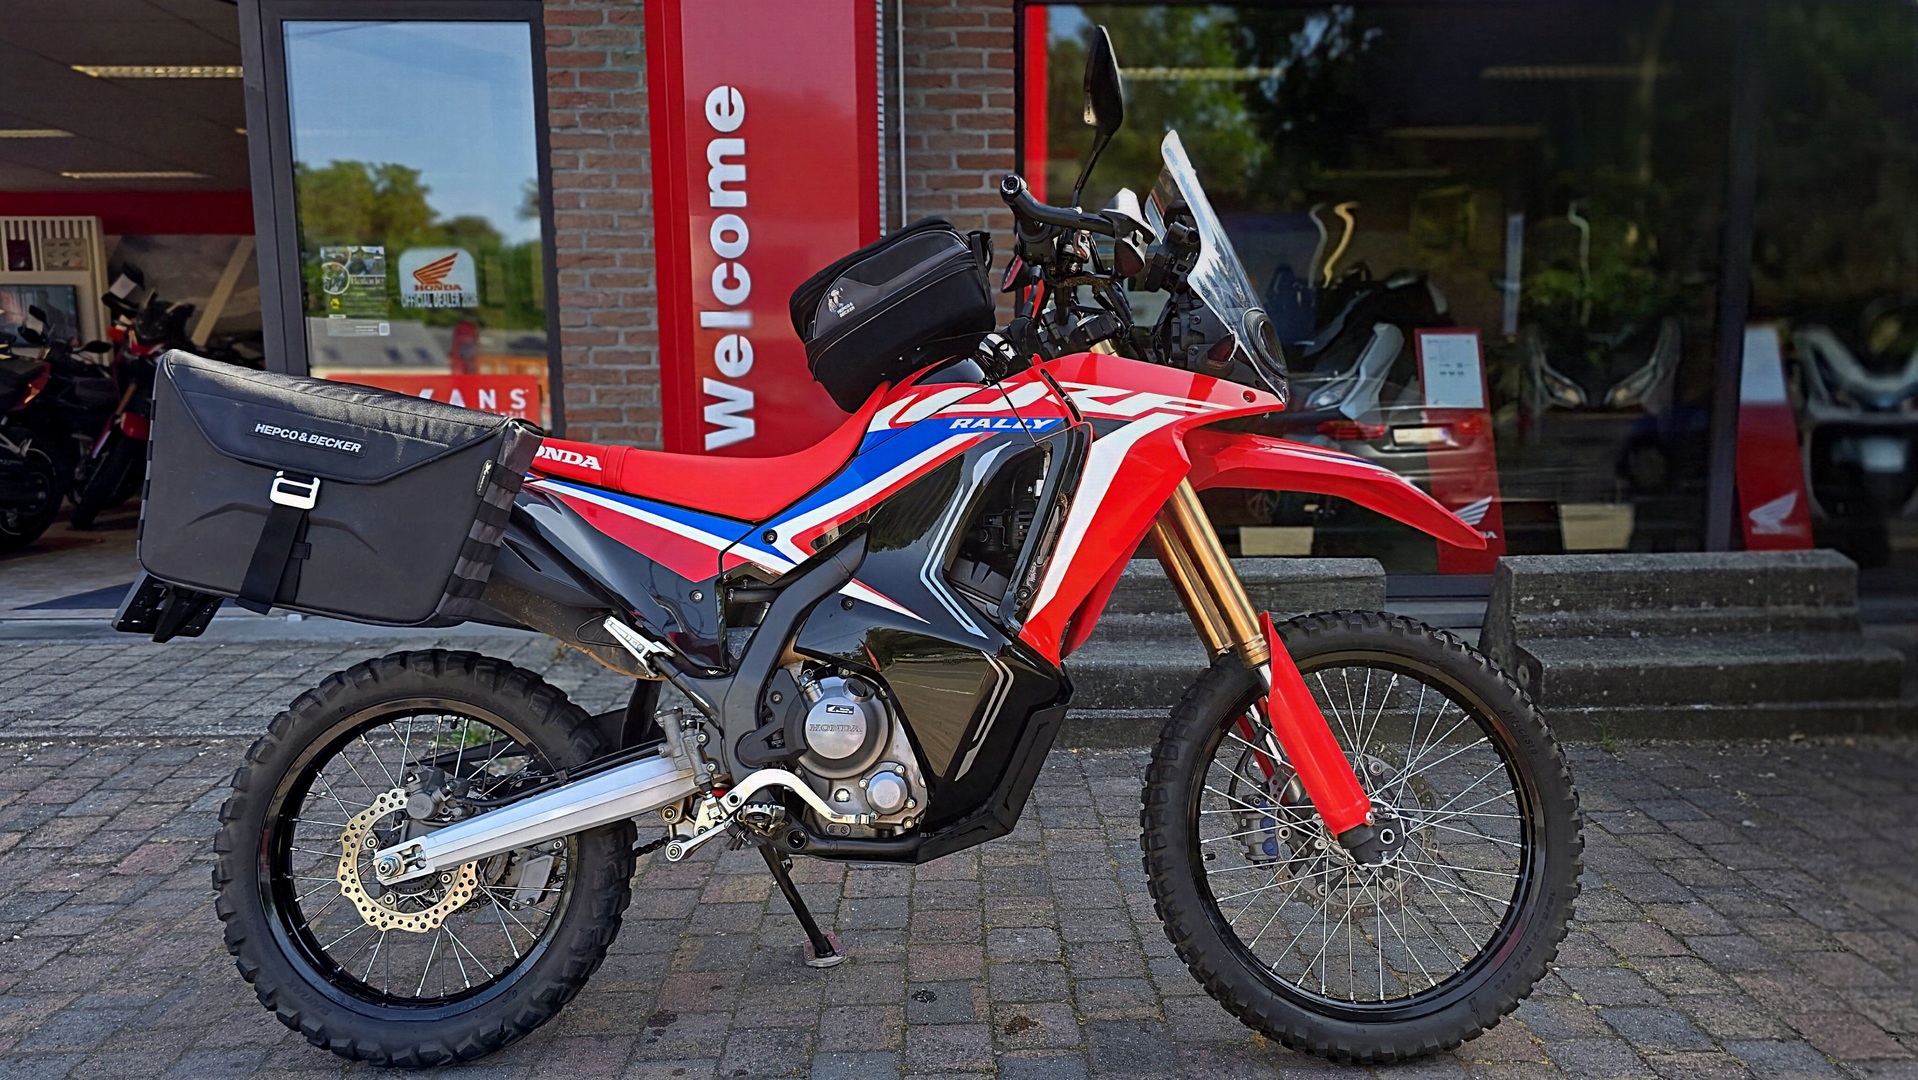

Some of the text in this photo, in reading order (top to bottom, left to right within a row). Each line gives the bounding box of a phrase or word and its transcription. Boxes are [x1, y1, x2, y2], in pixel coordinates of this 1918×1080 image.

[700, 85, 755, 451] Welcome
[434, 293, 461, 308] DEALER
[948, 417, 1057, 431] RALLY
[535, 445, 602, 471] ONDA
[809, 723, 862, 733] HONDA
